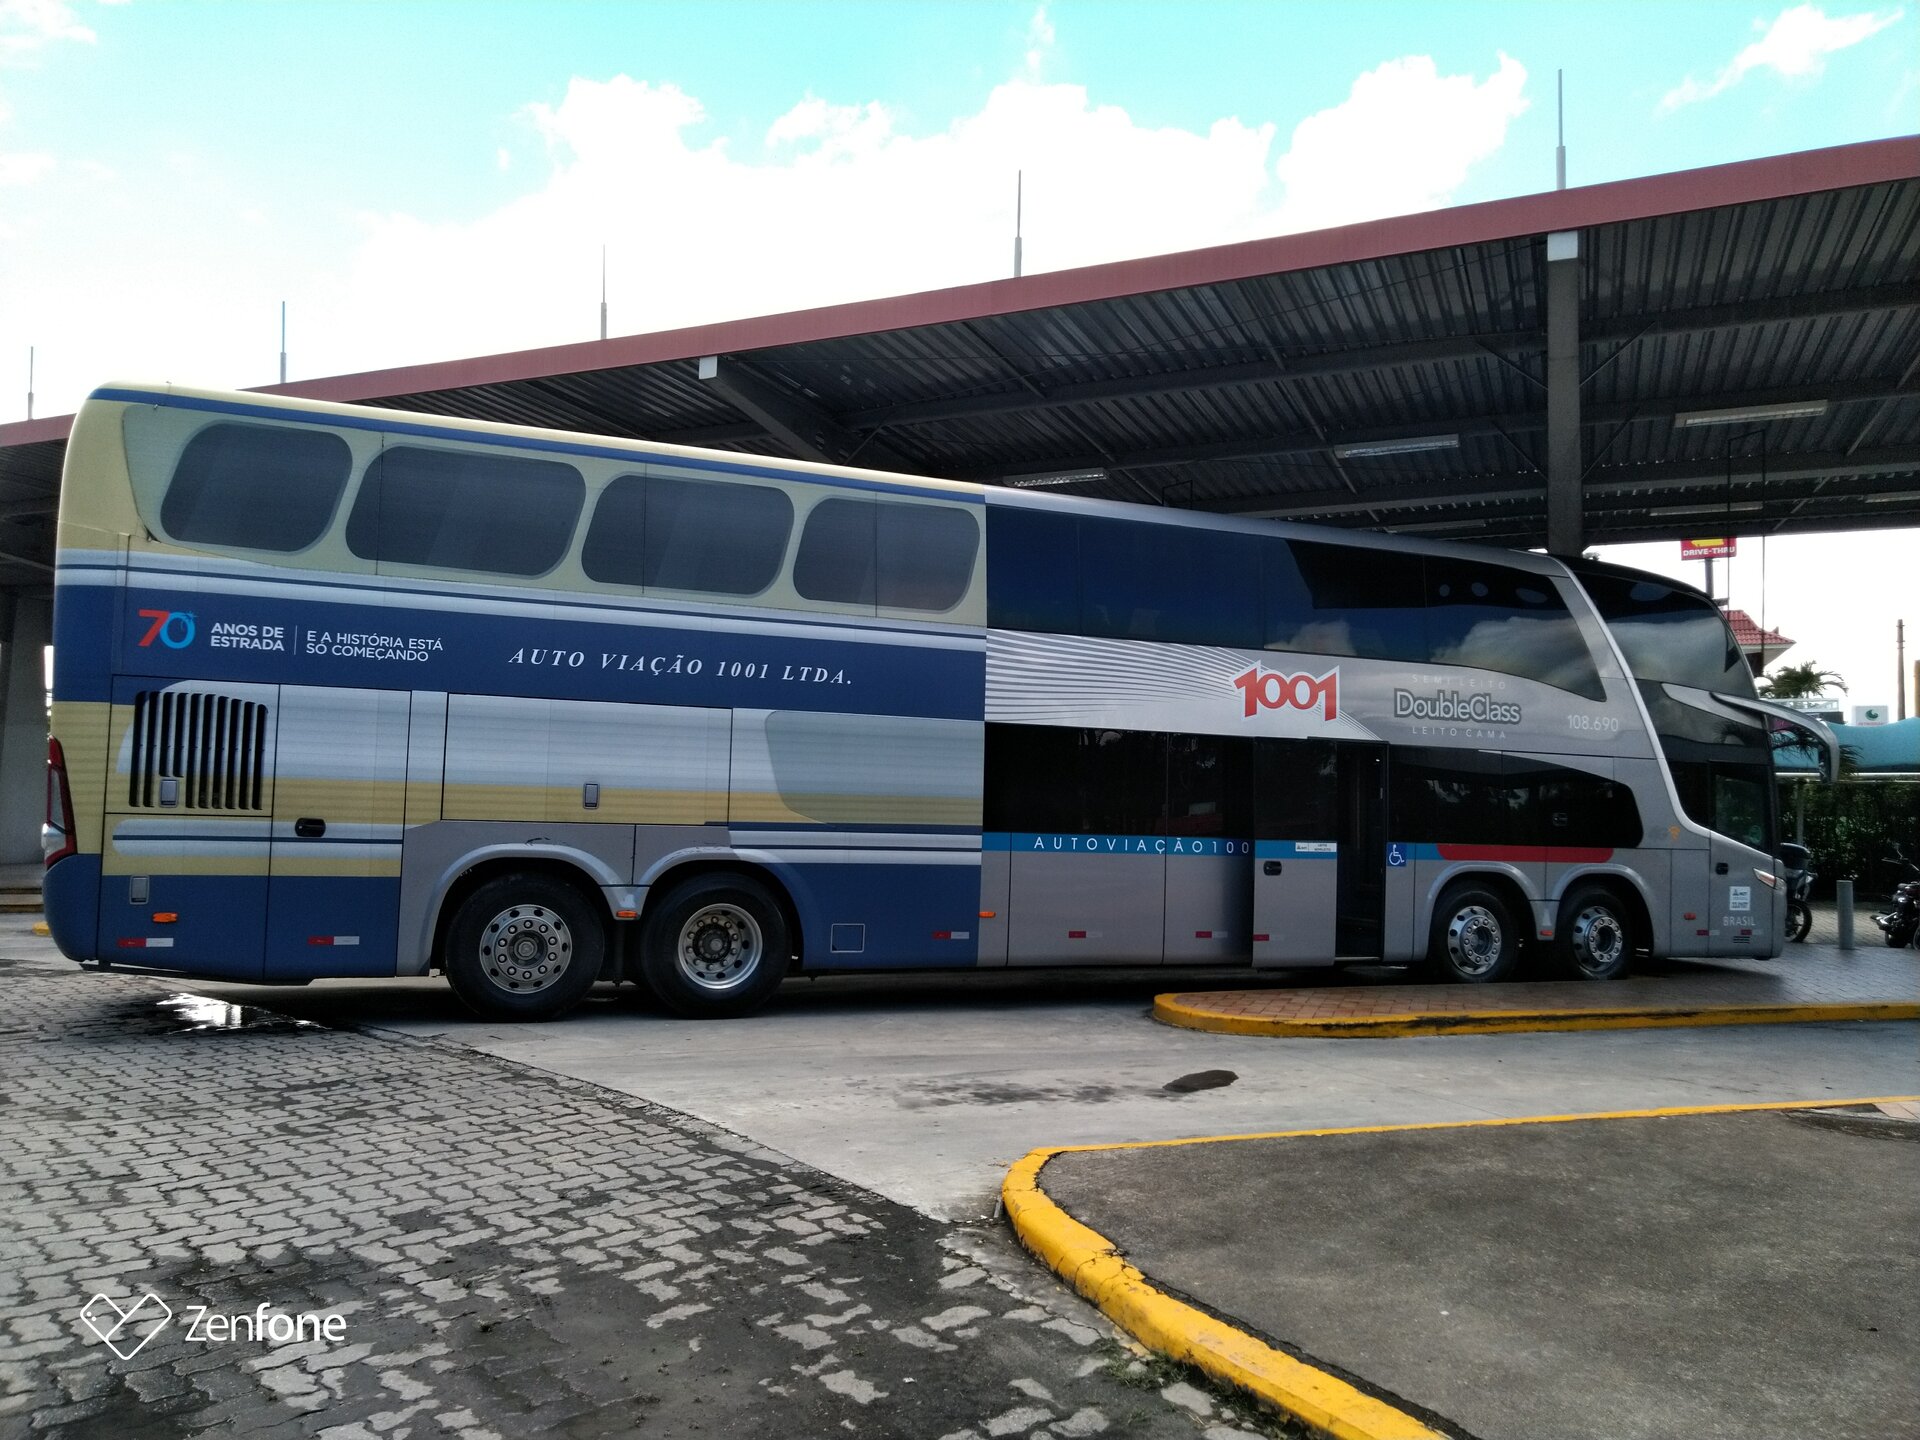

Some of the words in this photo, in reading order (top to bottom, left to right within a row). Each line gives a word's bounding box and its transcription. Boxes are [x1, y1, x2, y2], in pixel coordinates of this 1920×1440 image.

[1682, 546, 1735, 556] DRIVE-THRU
[138, 609, 196, 649] 70
[211, 622, 258, 638] ANOS
[262, 624, 284, 639] DE
[210, 635, 284, 651] ESTRADA
[307, 630, 317, 642] E
[321, 631, 332, 643] A
[337, 632, 404, 649] HISTÓRIA
[408, 637, 443, 651] ESTÁ
[306, 641, 327, 655] SÓ
[331, 645, 429, 662] COMEÇANDO
[508, 647, 586, 668] AUTO
[600, 653, 703, 676] VIAÇÃO
[716, 660, 769, 680] 1001
[781, 665, 852, 685] LTDA.
[1411, 674, 1451, 686] SEMI
[1458, 677, 1506, 690] LEITO
[1233, 665, 1338, 722] 1001
[1395, 690, 1521, 723] DoubleClass
[1566, 714, 1619, 732] 108.690
[1411, 726, 1457, 737] LEITO
[1465, 729, 1507, 740] CAMA
[1722, 916, 1756, 927] BRASIL
